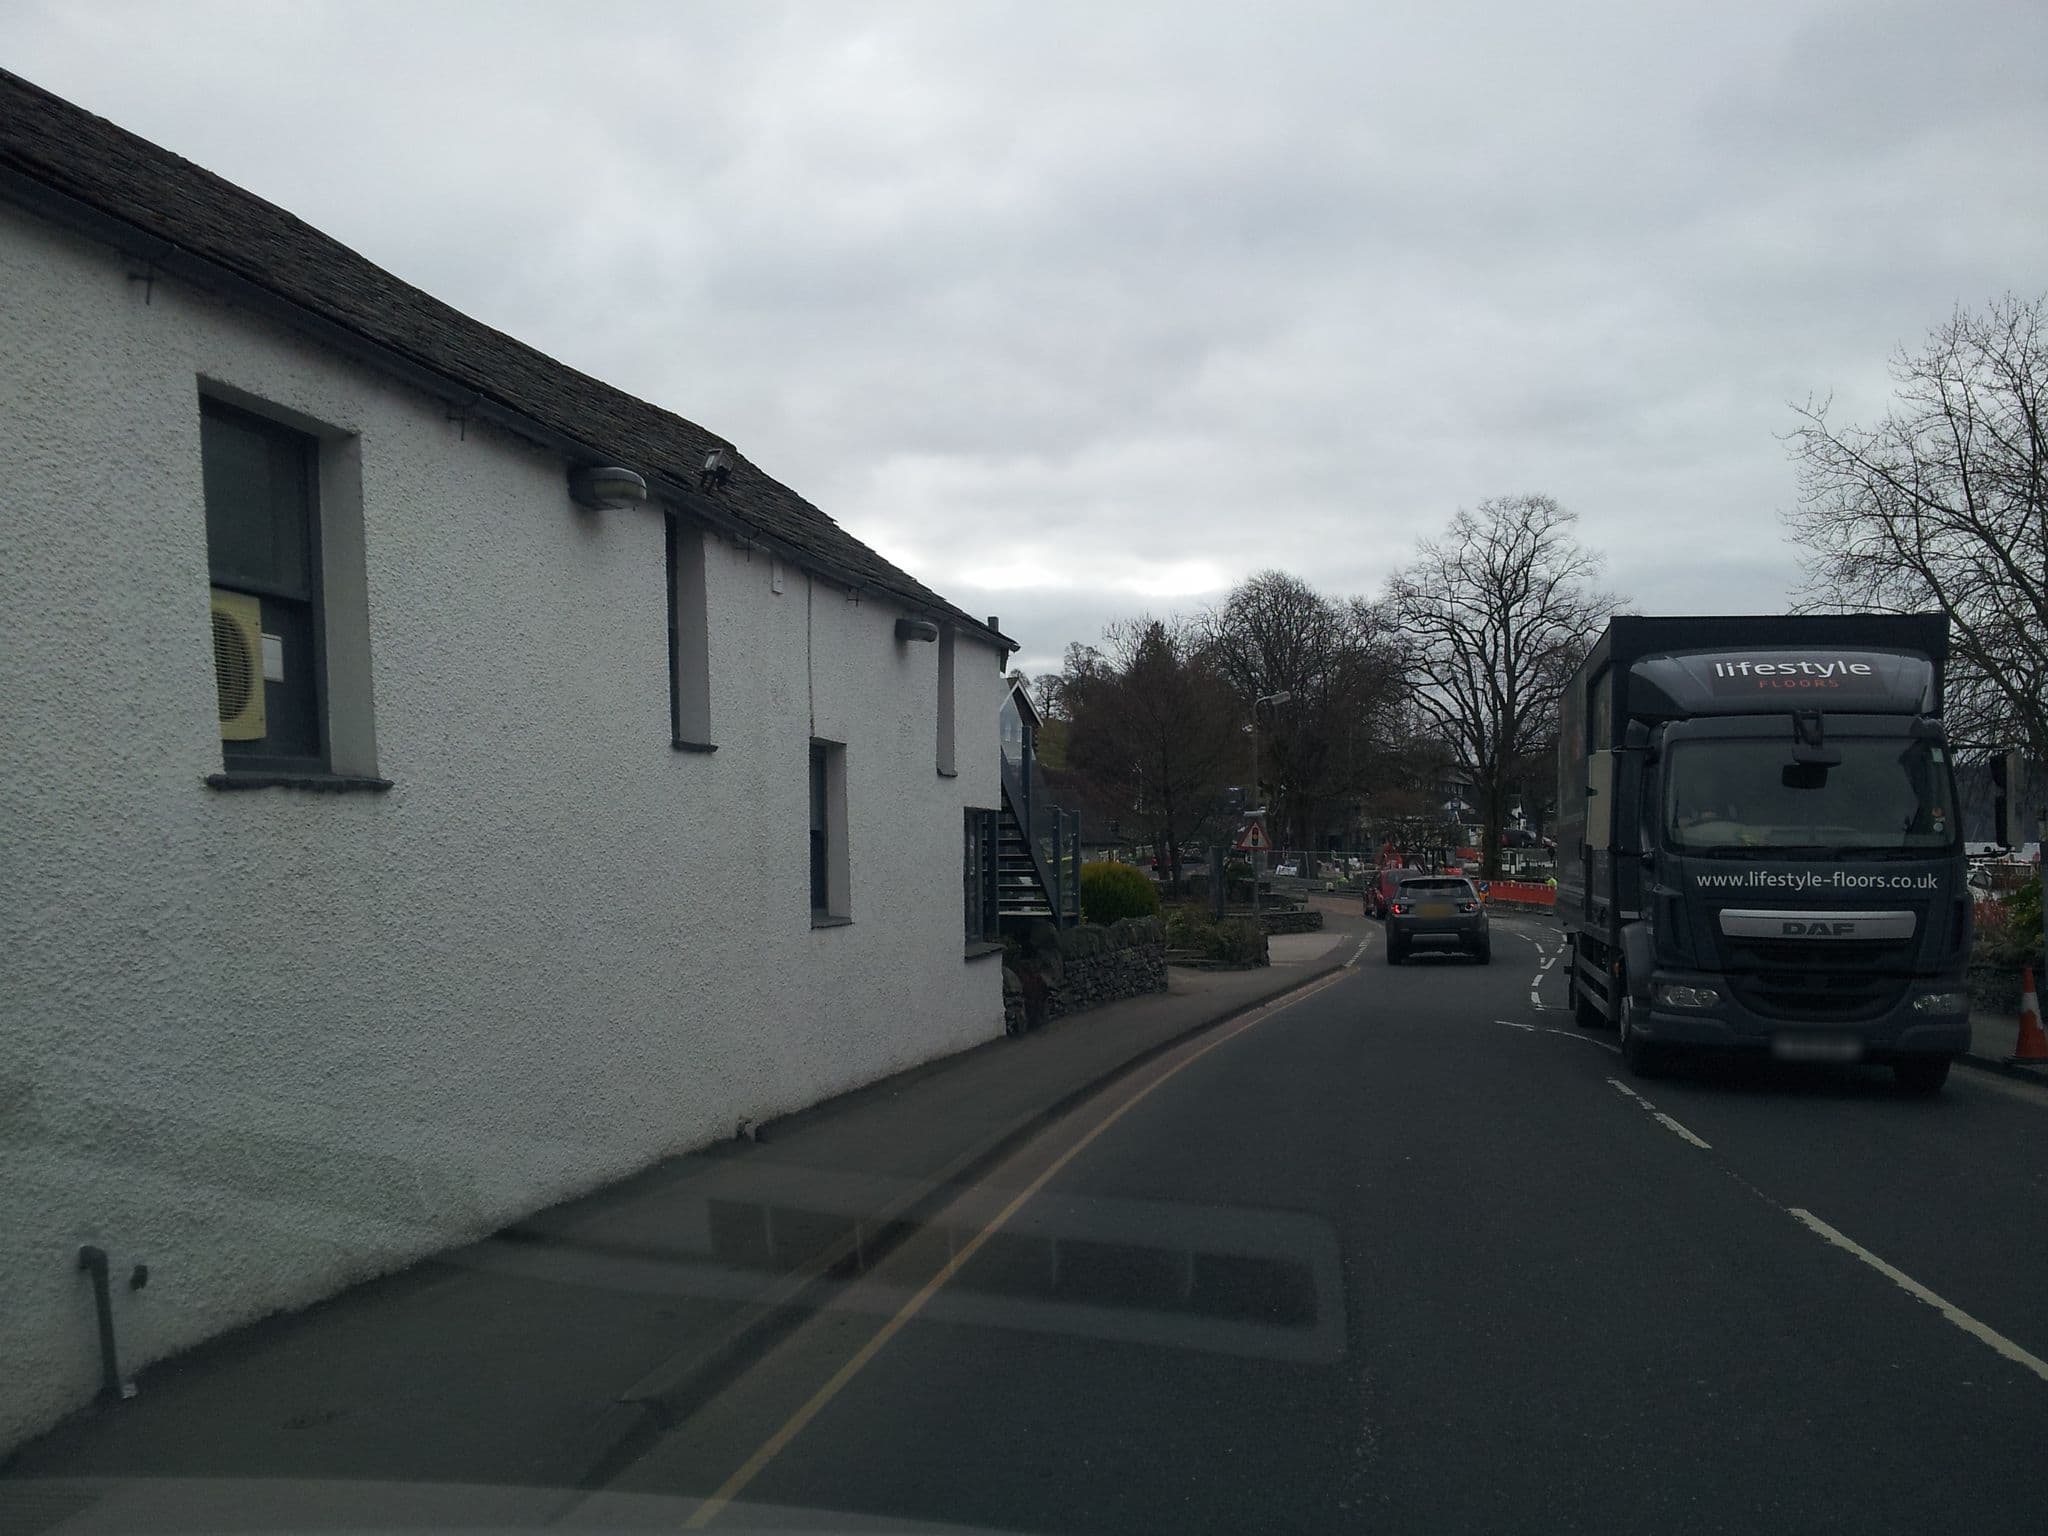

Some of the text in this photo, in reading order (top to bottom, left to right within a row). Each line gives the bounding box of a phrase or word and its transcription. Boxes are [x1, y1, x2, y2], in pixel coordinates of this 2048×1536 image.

[1715, 660, 1872, 678] lifestyle
[1759, 679, 1839, 689] FLOORS
[1697, 871, 1938, 890] www.lifestyle-floors.co.uk
[1782, 922, 1856, 936] DAF
